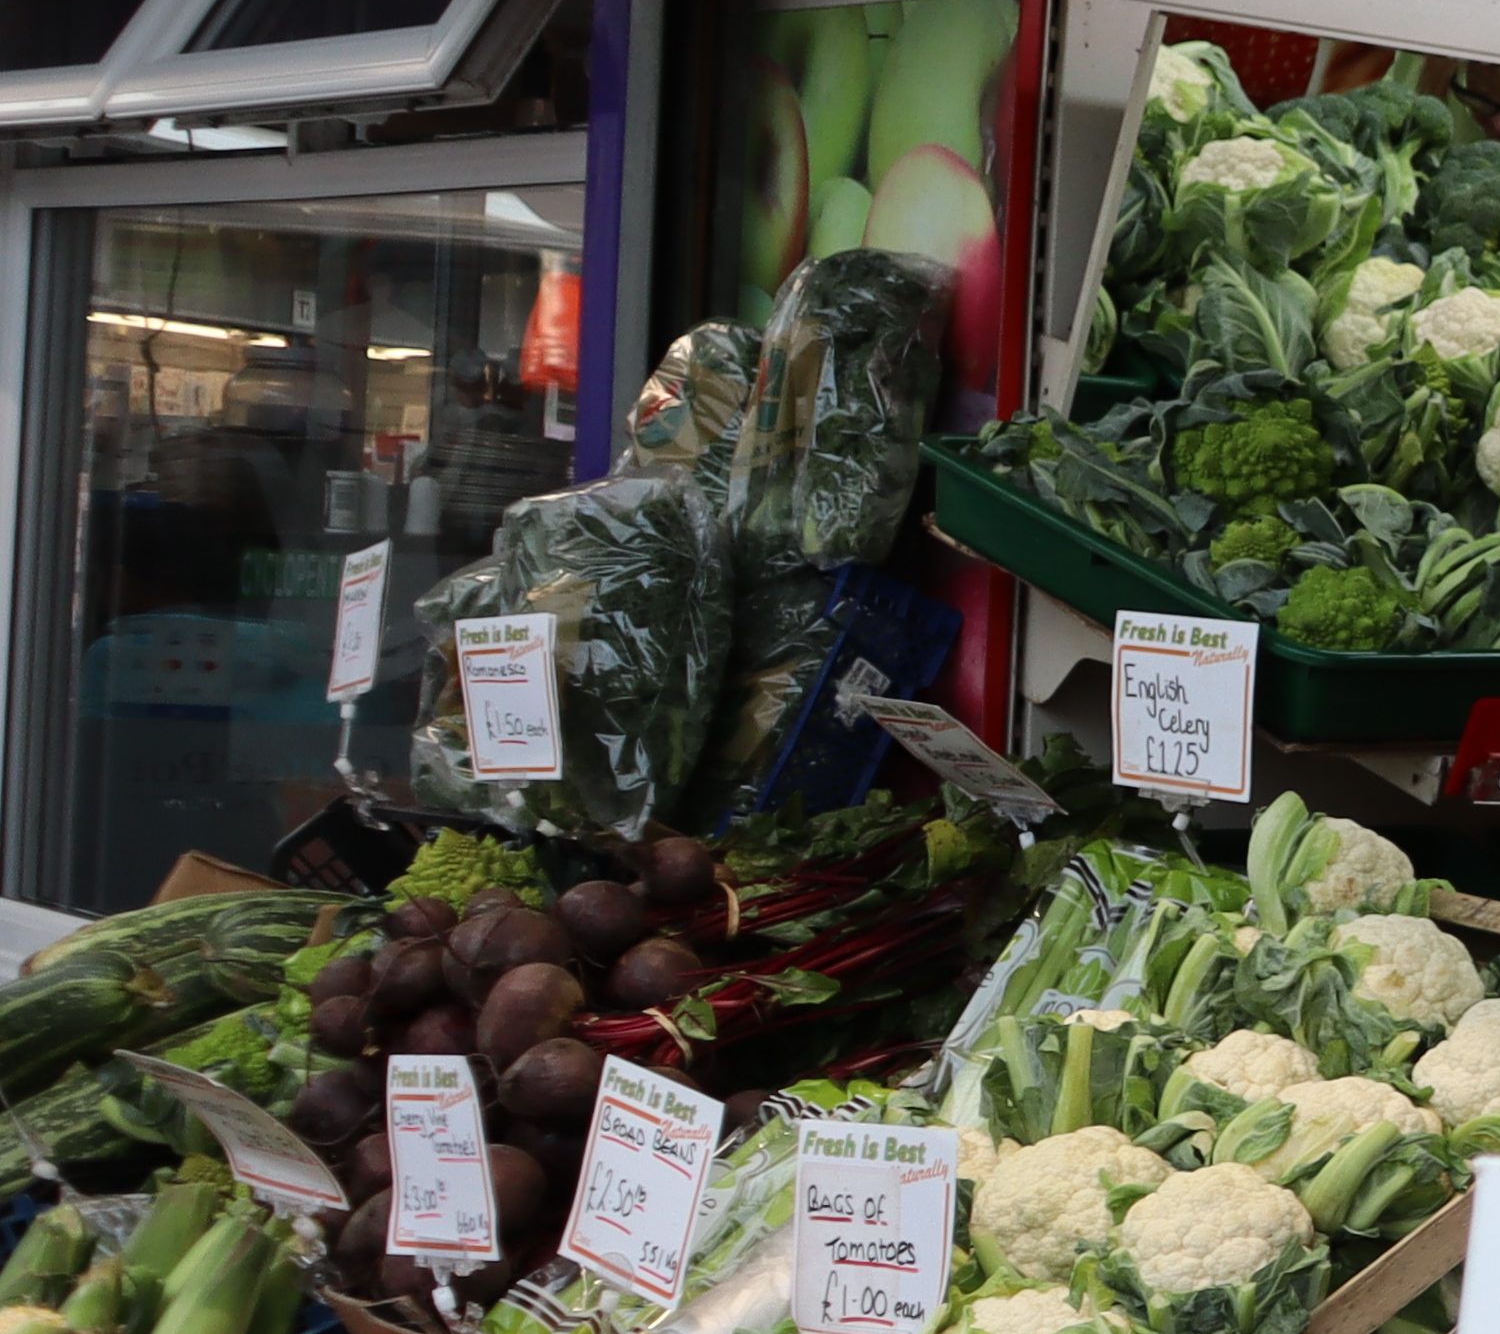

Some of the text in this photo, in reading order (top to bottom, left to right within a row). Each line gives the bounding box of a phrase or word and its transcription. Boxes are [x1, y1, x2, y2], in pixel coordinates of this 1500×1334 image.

[1123, 663, 1189, 718] English
[1158, 707, 1210, 754] Celery
[600, 1105, 698, 1166] BROAD BEANS
[894, 1300, 925, 1322] each
